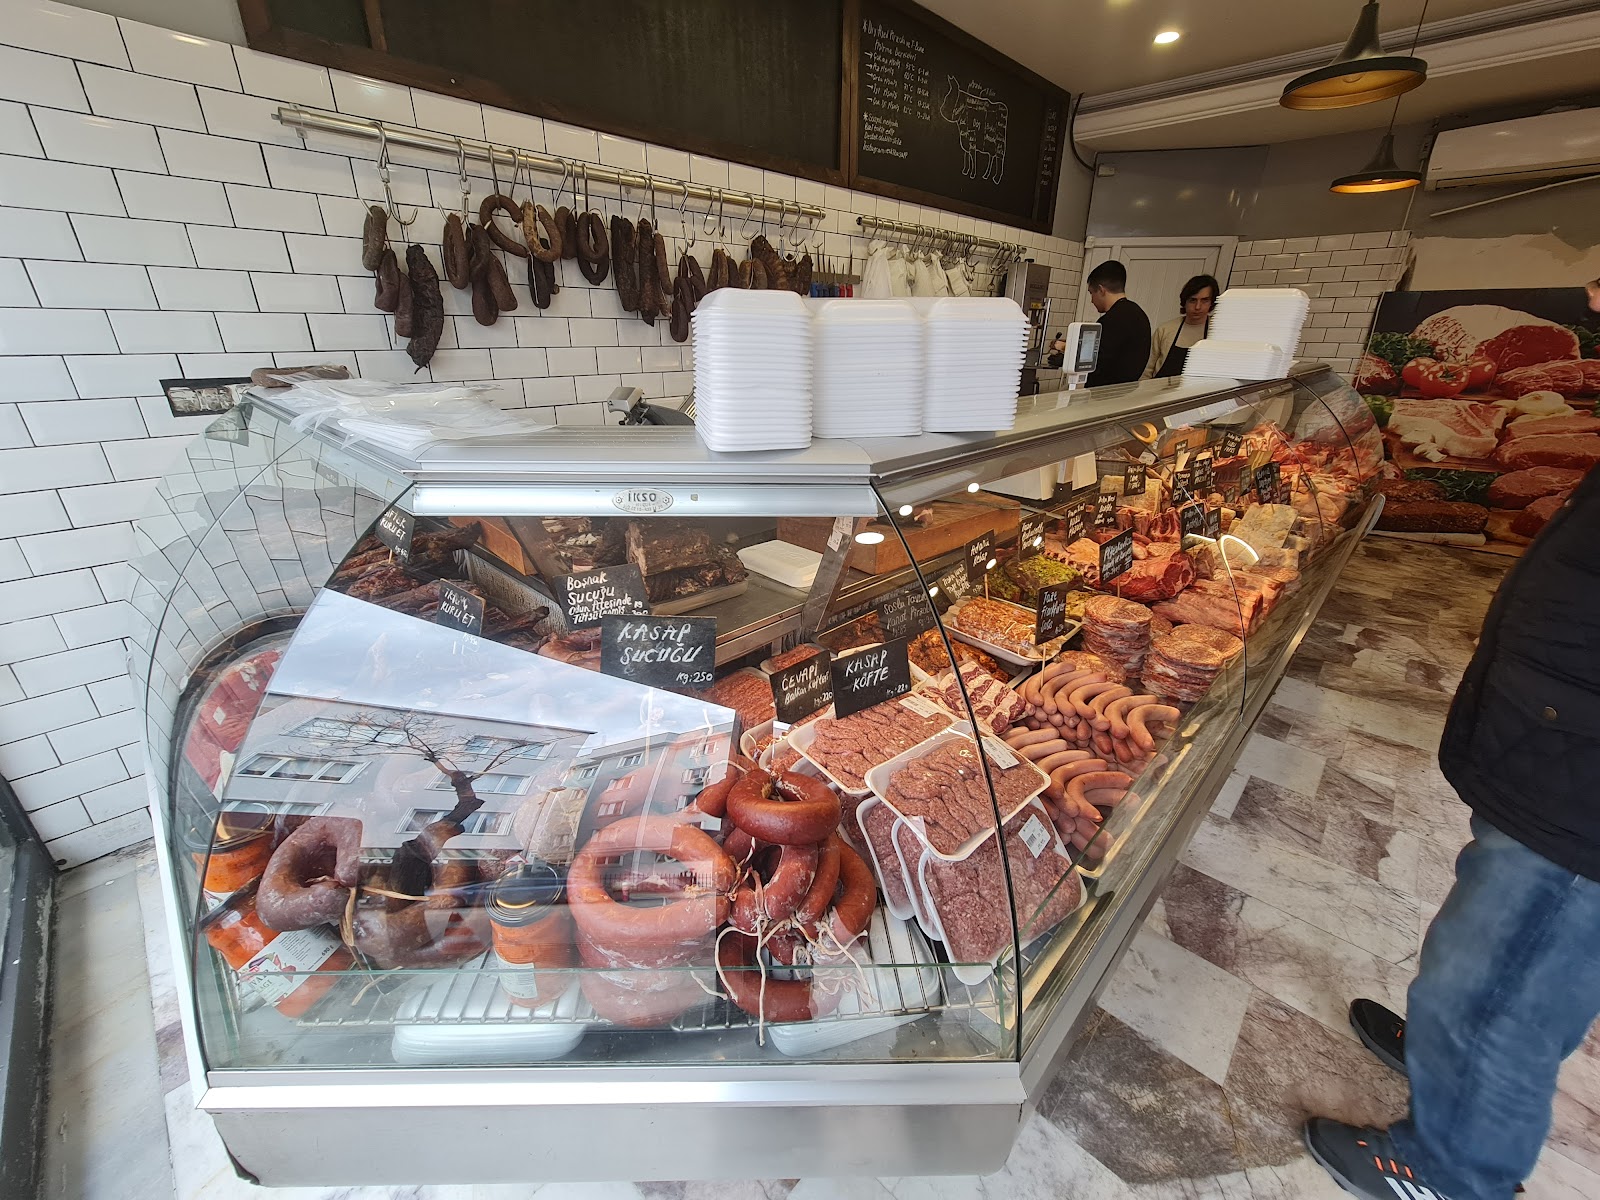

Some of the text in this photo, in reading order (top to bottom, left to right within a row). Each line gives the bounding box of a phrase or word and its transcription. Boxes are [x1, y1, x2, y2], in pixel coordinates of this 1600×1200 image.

[567, 571, 608, 591] Boşnak
[617, 621, 691, 643] KASAP
[846, 650, 888, 677] KASAP
[852, 666, 889, 692] KÖFTE
